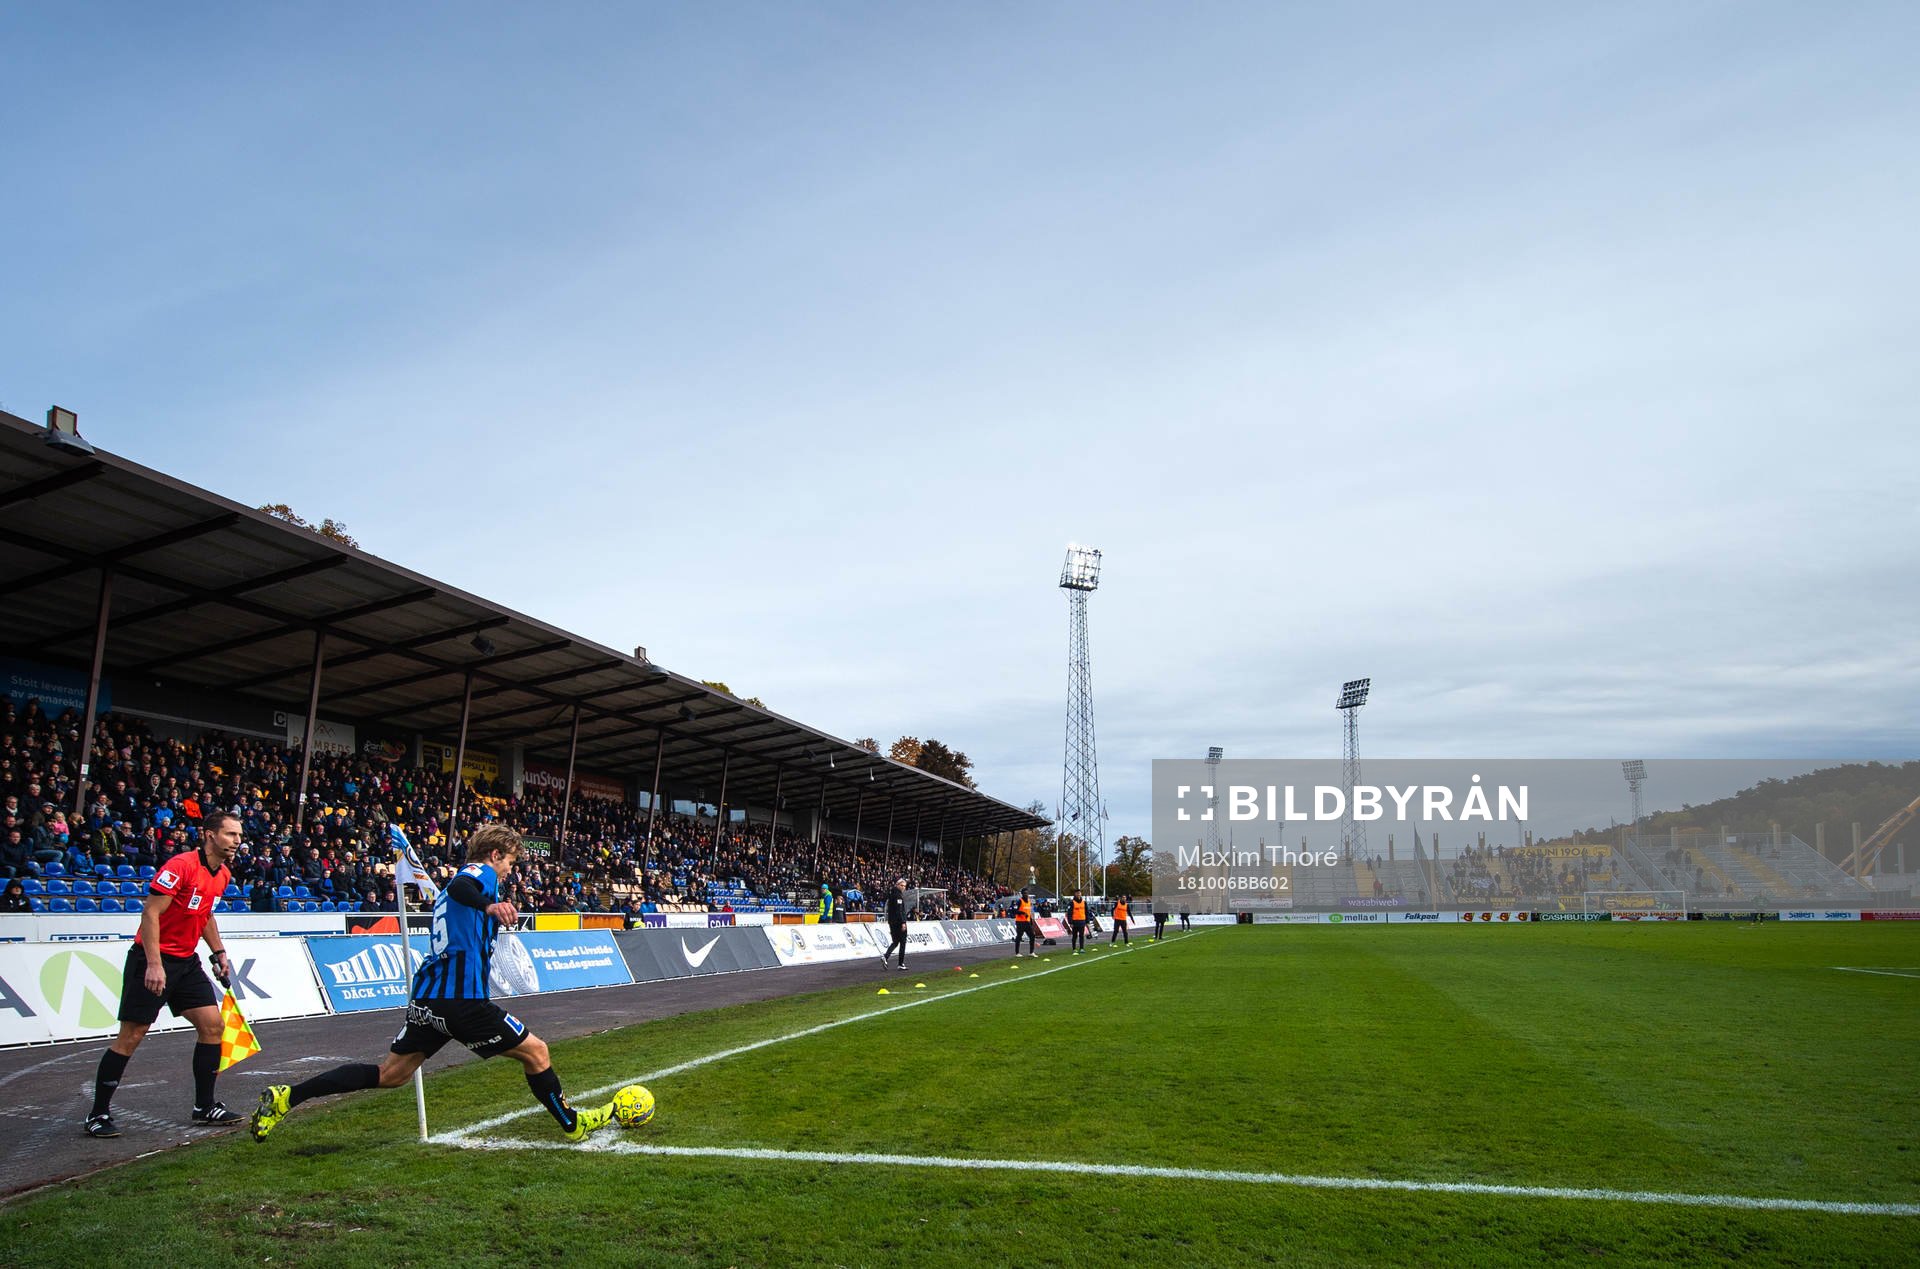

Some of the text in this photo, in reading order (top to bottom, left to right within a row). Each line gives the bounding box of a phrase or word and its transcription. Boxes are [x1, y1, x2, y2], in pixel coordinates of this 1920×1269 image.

[10, 675, 39, 689] Stolt
[10, 689, 86, 709] av arenarekla
[275, 712, 286, 725] C
[520, 841, 551, 850] NICKERI
[1347, 897, 1399, 907] wasabiweb
[531, 947, 557, 959] Däck
[341, 986, 377, 1000] DÄCK
